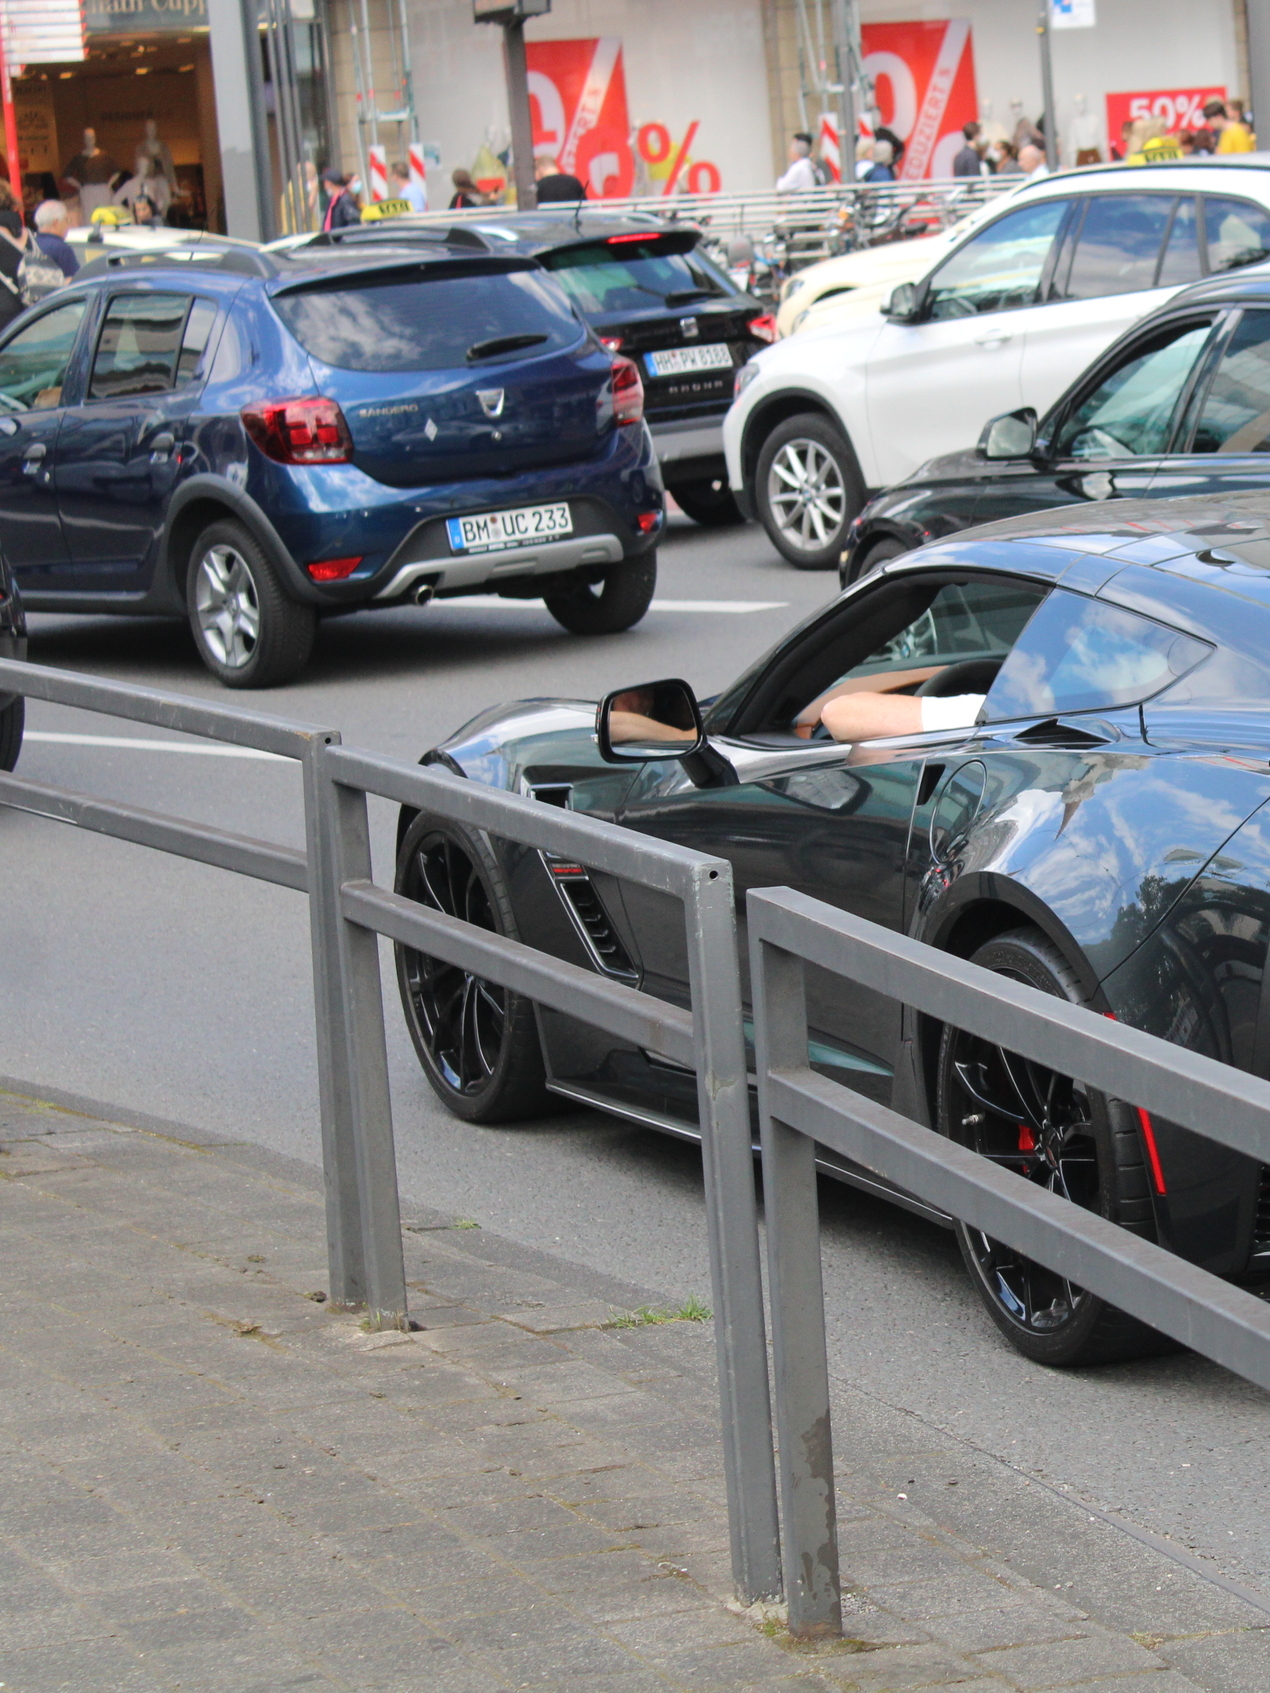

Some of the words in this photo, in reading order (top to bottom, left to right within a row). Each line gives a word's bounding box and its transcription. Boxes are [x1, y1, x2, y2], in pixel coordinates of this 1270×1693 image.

[462, 519, 490, 542] BM
[501, 513, 528, 536] UC
[532, 507, 569, 533] 233
